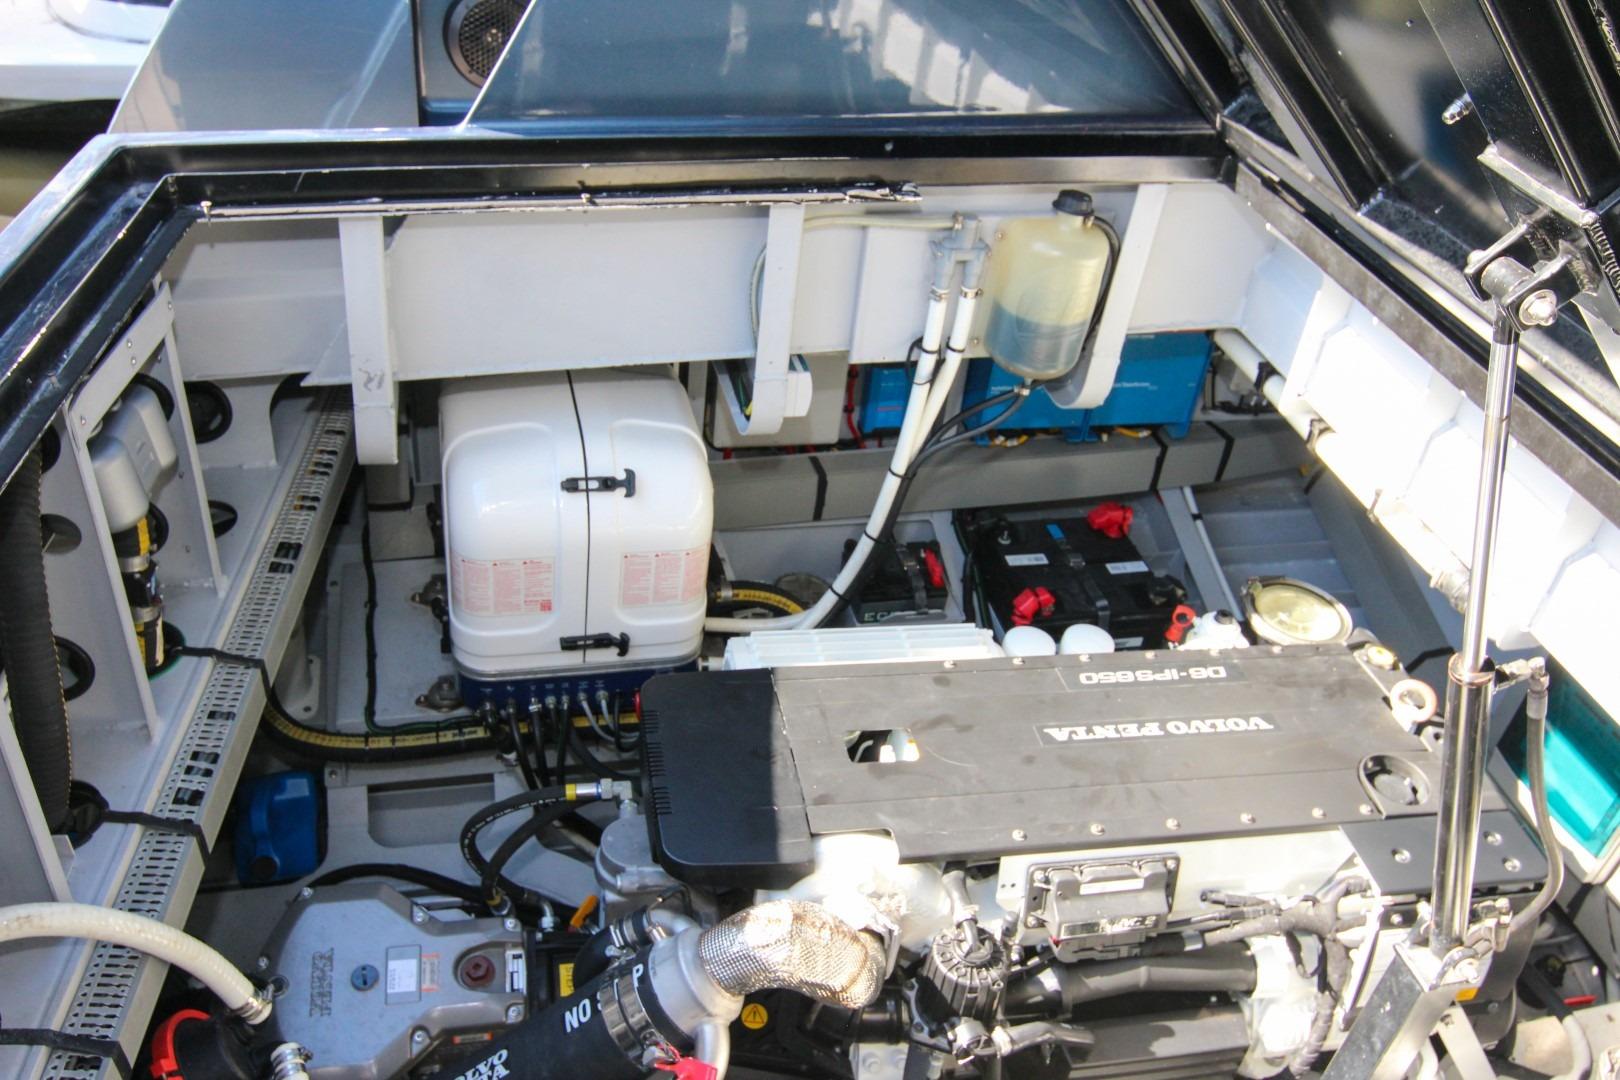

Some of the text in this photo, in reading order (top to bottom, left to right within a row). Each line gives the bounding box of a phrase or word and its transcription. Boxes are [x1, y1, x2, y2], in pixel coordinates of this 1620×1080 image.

[1079, 667, 1226, 685] D6-IPS650
[1044, 717, 1274, 742] VOLVO PENTA
[564, 998, 591, 1033] NO
[454, 1048, 508, 1080] LVO
